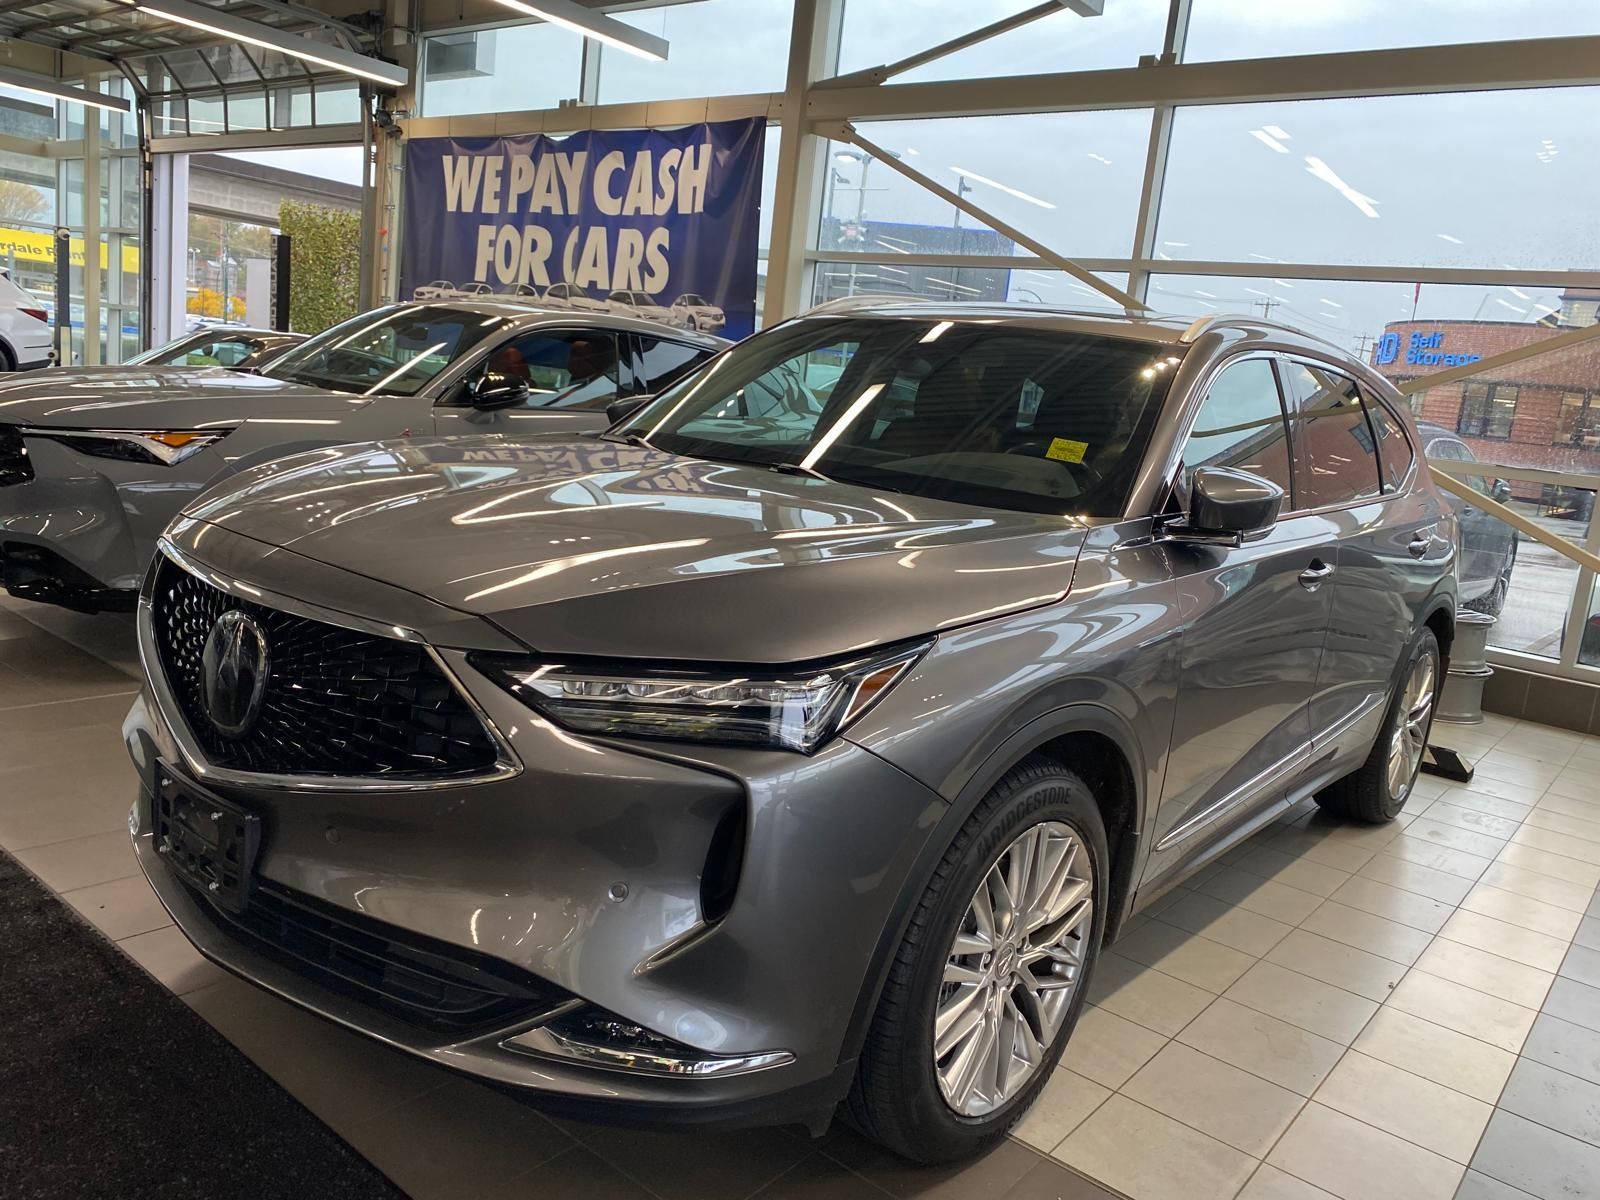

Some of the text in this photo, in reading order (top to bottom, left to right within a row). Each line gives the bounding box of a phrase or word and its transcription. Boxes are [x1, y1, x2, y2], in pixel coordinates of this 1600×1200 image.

[442, 143, 712, 217] WE PAY CASH
[474, 223, 670, 295] FOR CARS
[1409, 330, 1443, 349] Self
[977, 786, 1072, 862] BRIDGESTONE
